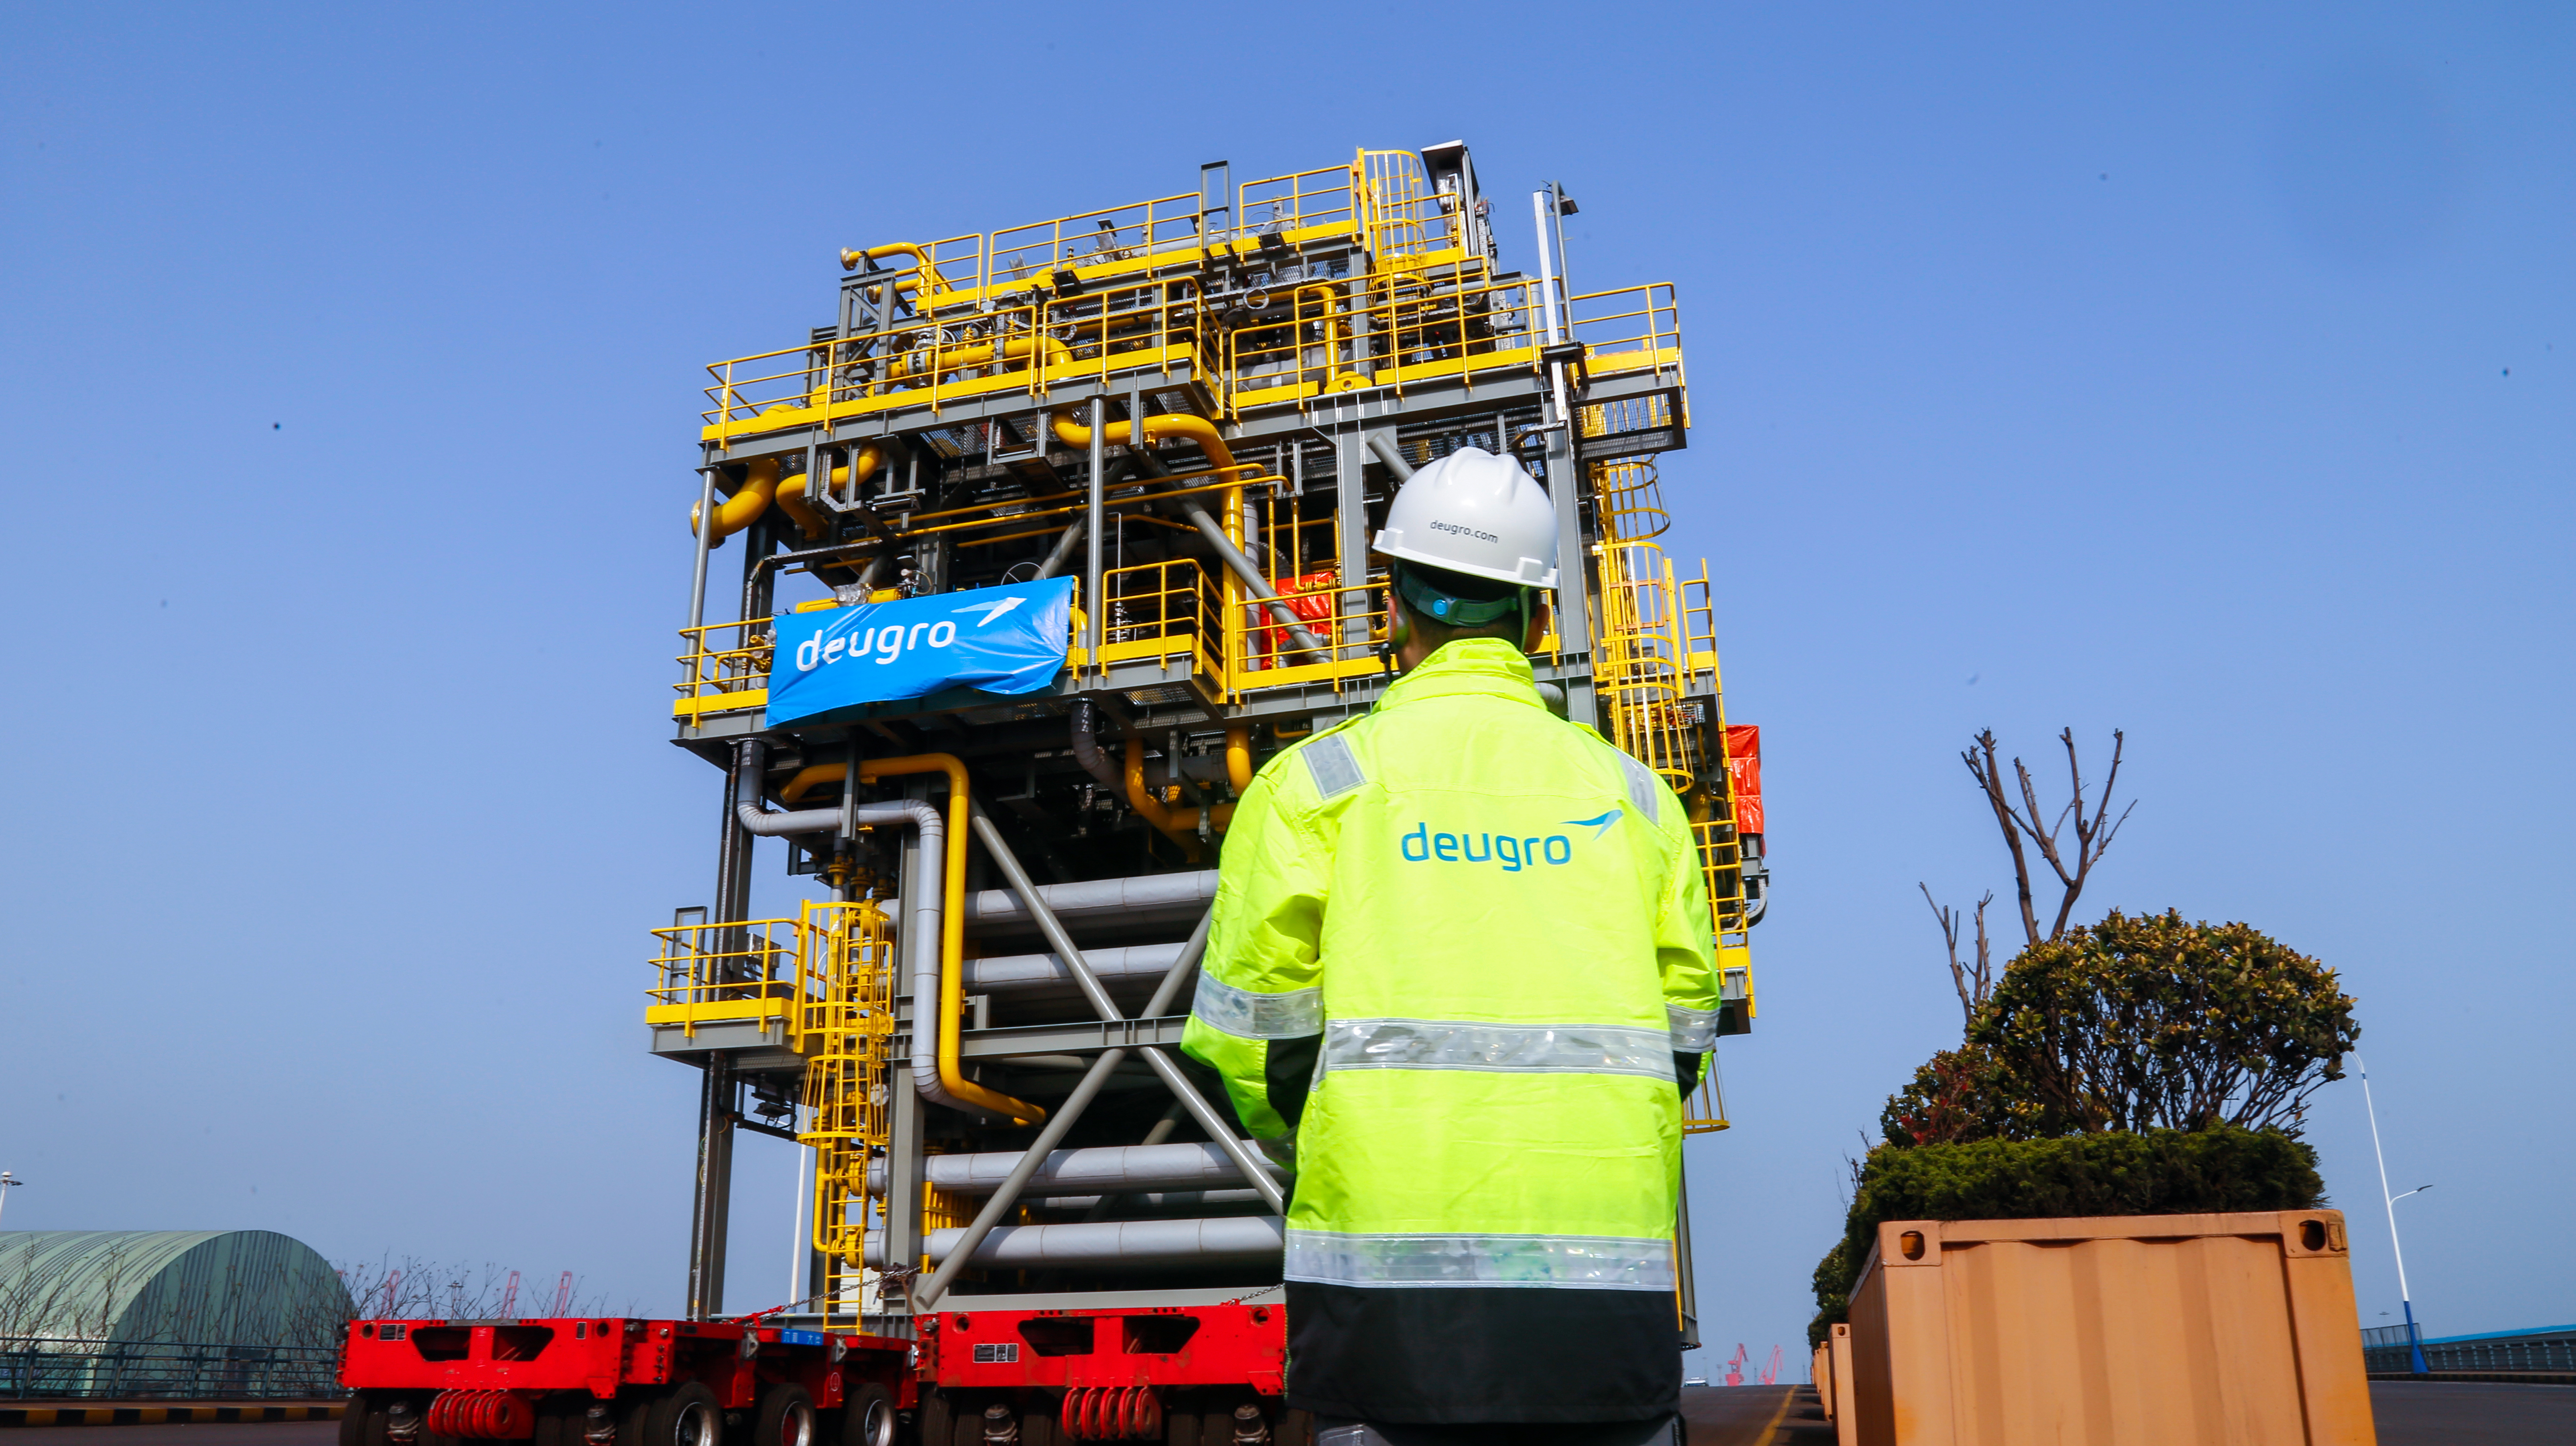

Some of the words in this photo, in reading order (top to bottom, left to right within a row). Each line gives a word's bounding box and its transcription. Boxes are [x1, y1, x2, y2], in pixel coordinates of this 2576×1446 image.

[1430, 520, 1498, 543] deugro.com
[797, 621, 956, 672] deugro
[1402, 822, 1571, 871] deugro
